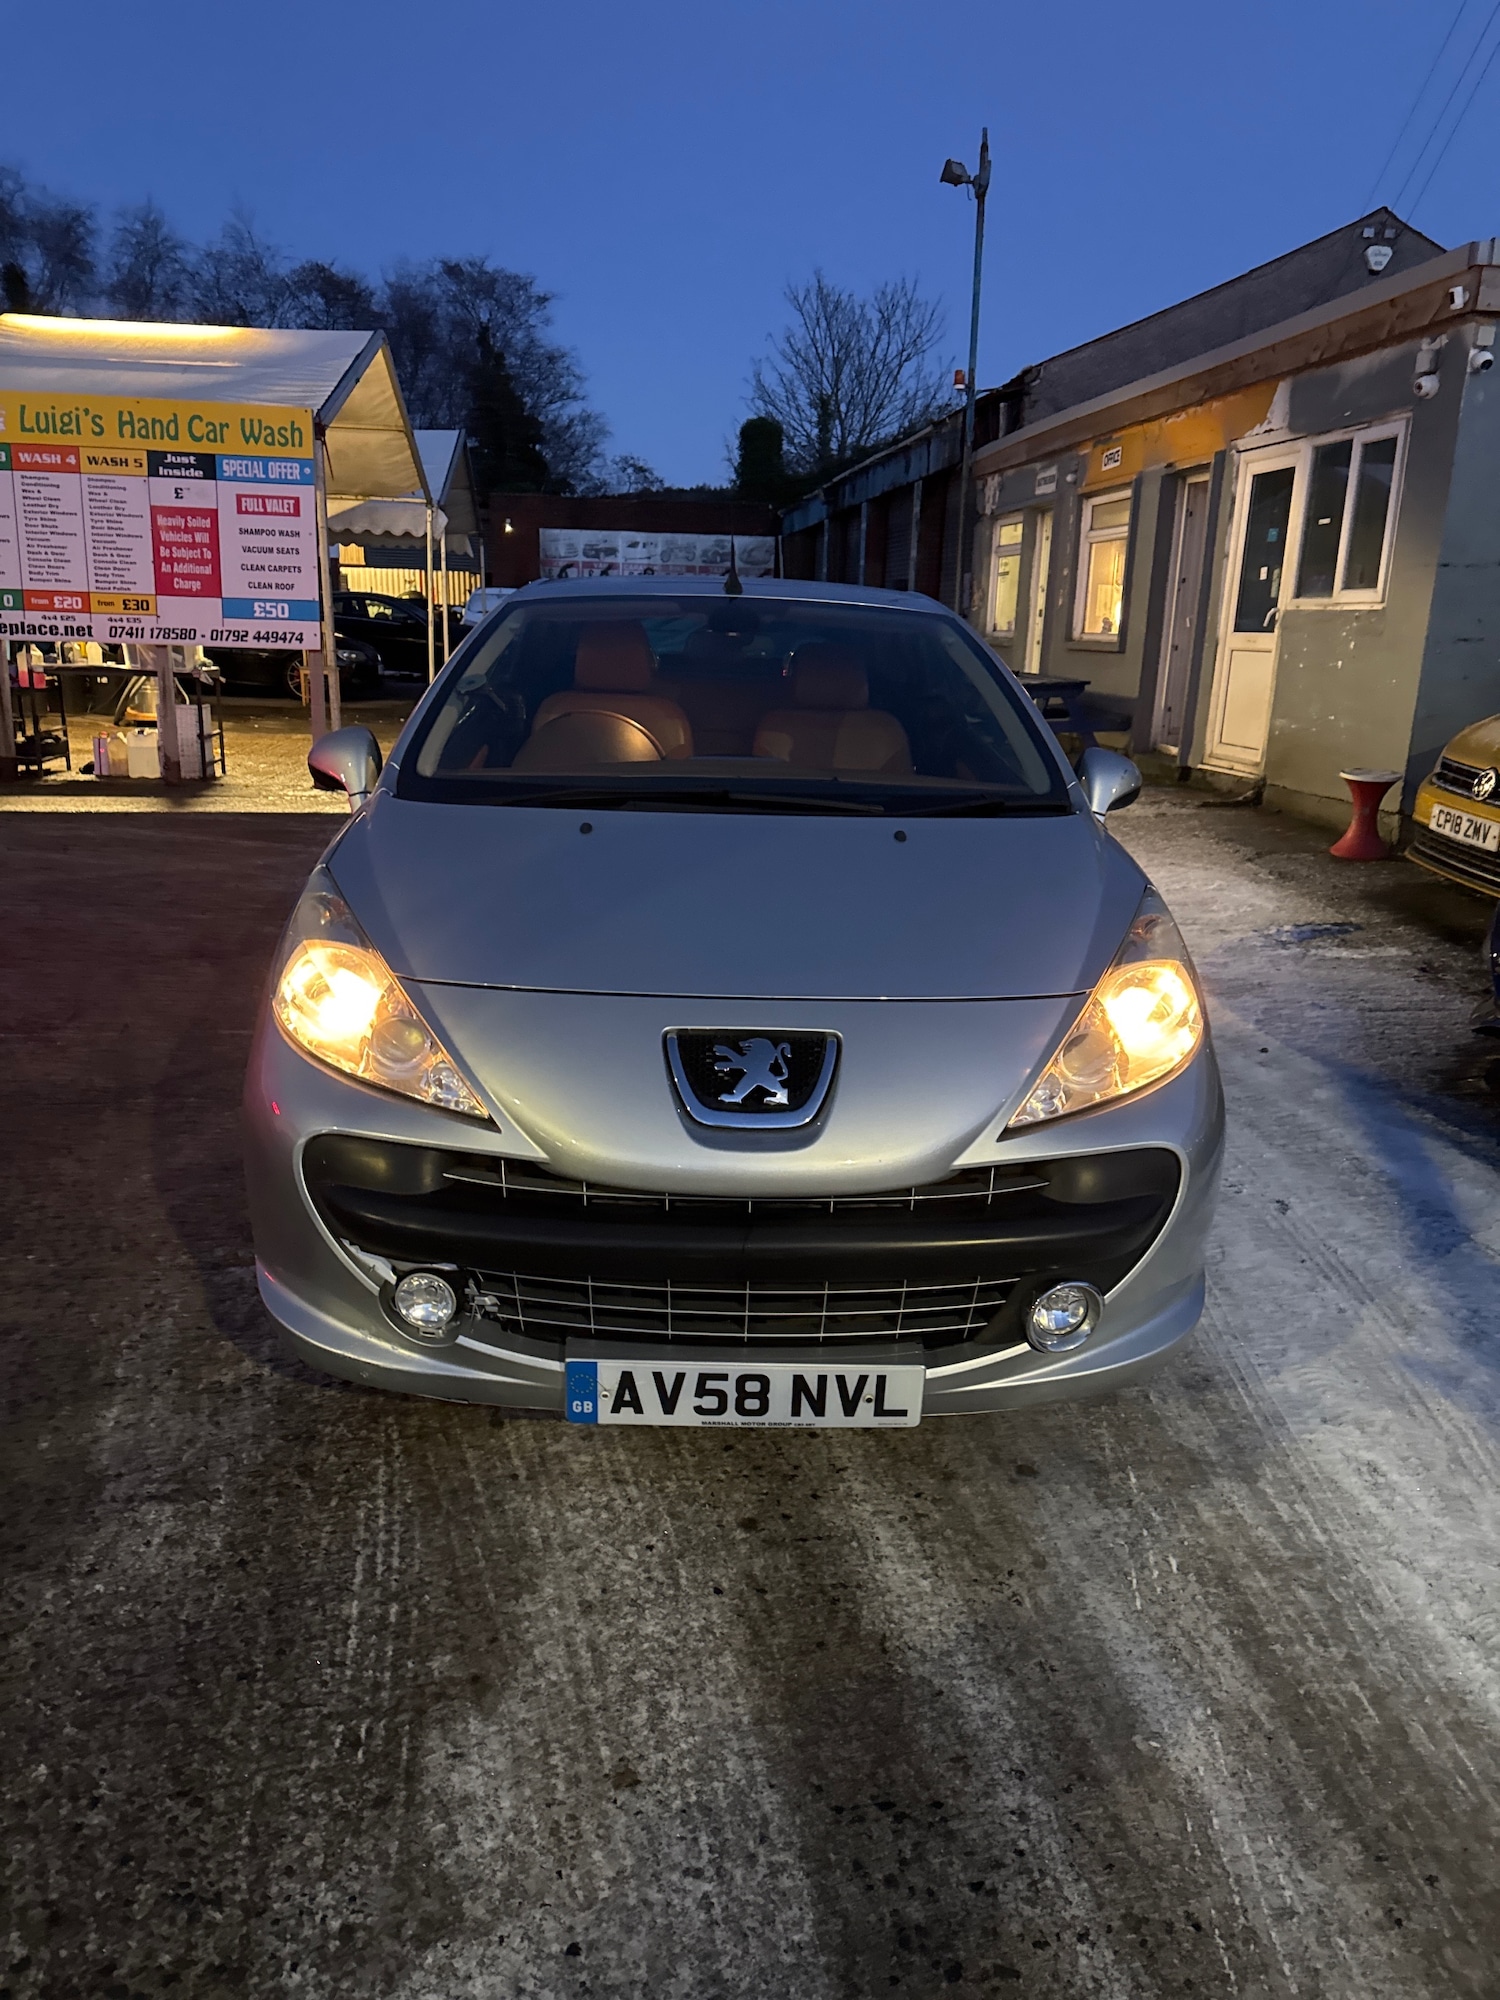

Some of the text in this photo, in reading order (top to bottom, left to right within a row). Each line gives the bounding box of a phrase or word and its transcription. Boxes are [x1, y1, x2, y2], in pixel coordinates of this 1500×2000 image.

[20, 404, 303, 448] Luigi's Hand Car Wash
[18, 452, 77, 465] WASH 4
[86, 455, 143, 468] WASH 5
[164, 454, 197, 464] Just
[158, 466, 204, 478] Inside
[222, 459, 300, 480] SPECIAL OFFER
[241, 497, 295, 514] FULL VALET
[157, 514, 211, 529] Heavily Soiled
[160, 530, 210, 544] Vehicles Will
[238, 527, 301, 538] SHAMPOO WASH
[160, 546, 212, 560] Be Subject To
[241, 545, 300, 555] VACUUM SEATS
[161, 562, 212, 575] An Additional
[240, 563, 302, 574] CLEAN CARPETS
[173, 578, 202, 592] Charge
[248, 581, 295, 591] CLEAN ROOF
[31, 596, 82, 609] from £20
[122, 599, 150, 611] £30
[253, 602, 289, 618] £50
[109, 626, 145, 639] 07411
[150, 627, 197, 640] 178580
[210, 629, 249, 642] 01792
[252, 631, 304, 644] 449474
[1436, 809, 1491, 844] CP18 ZMV
[610, 1371, 908, 1418] AV58 NVL
[572, 1401, 593, 1413] GB
